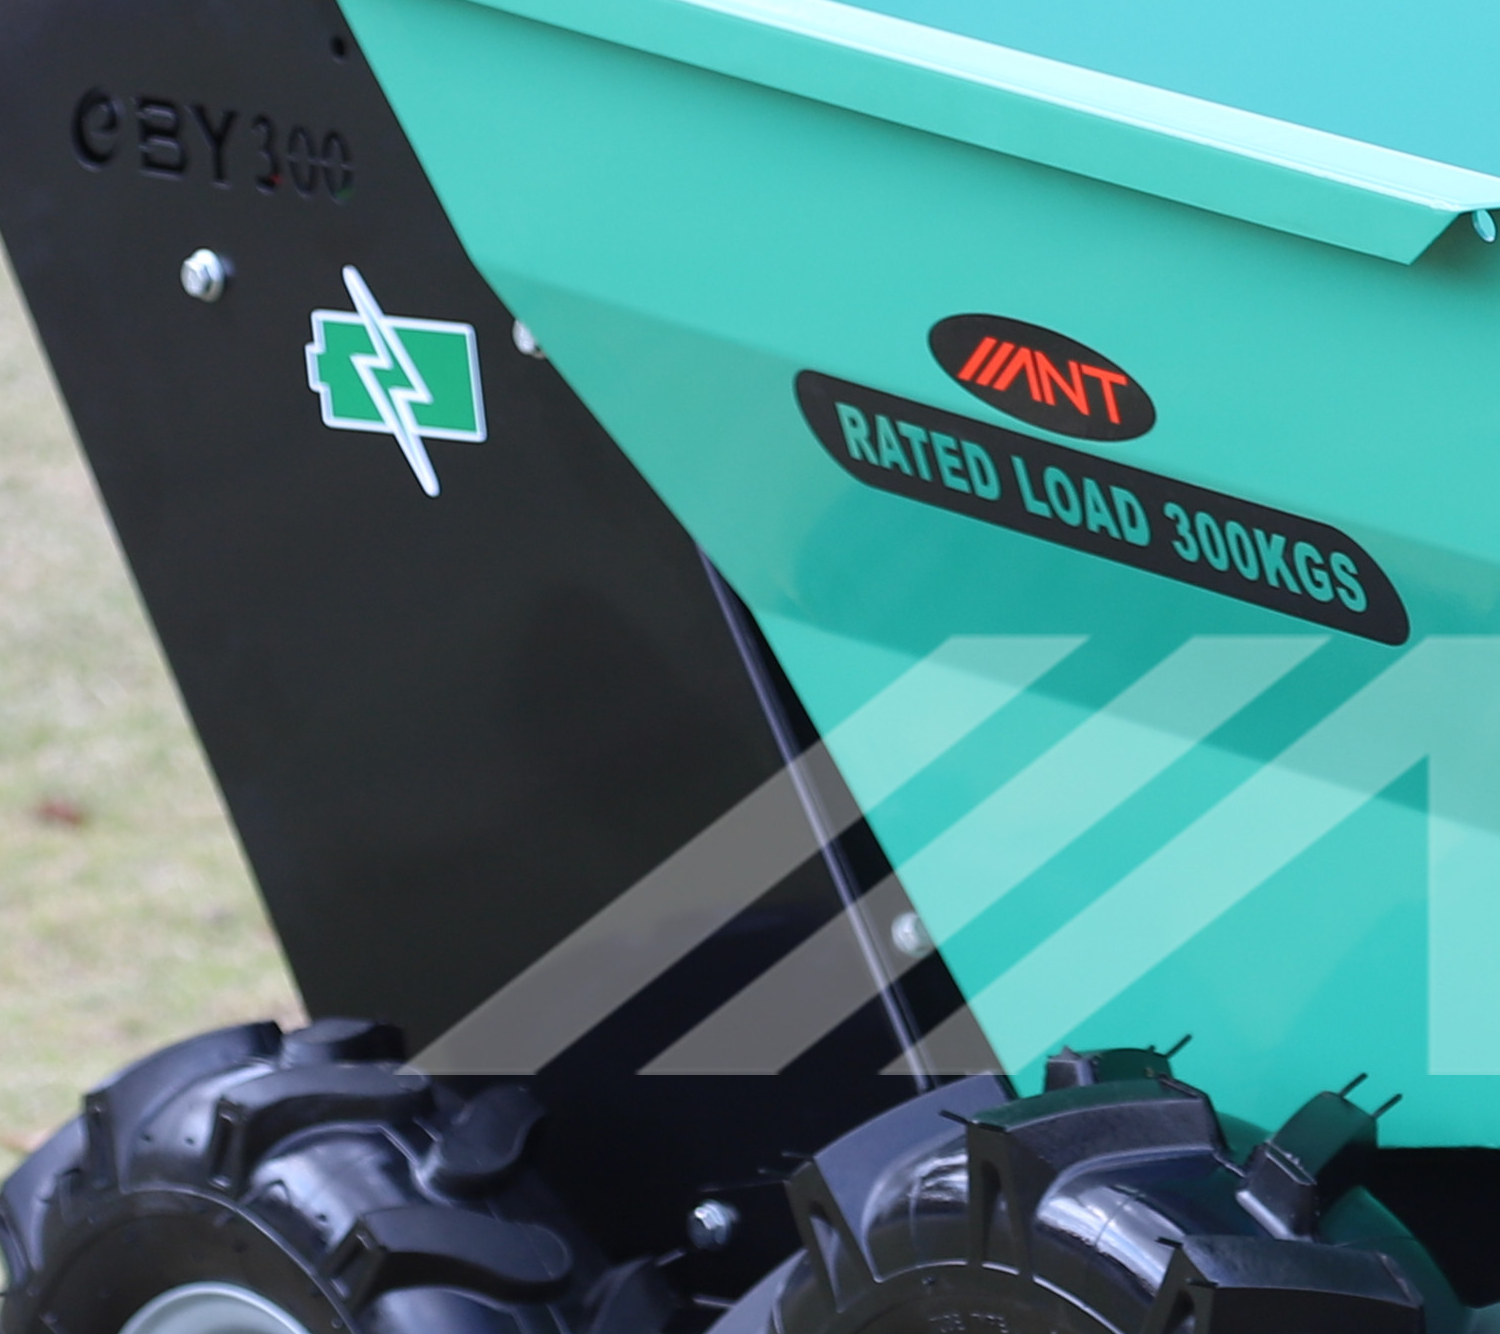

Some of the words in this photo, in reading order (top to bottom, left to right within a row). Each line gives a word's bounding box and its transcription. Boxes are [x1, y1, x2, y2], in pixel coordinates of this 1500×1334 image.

[835, 402, 1001, 501] RATED
[1011, 455, 1151, 547] LOAD
[1163, 502, 1368, 613] 300KGS
